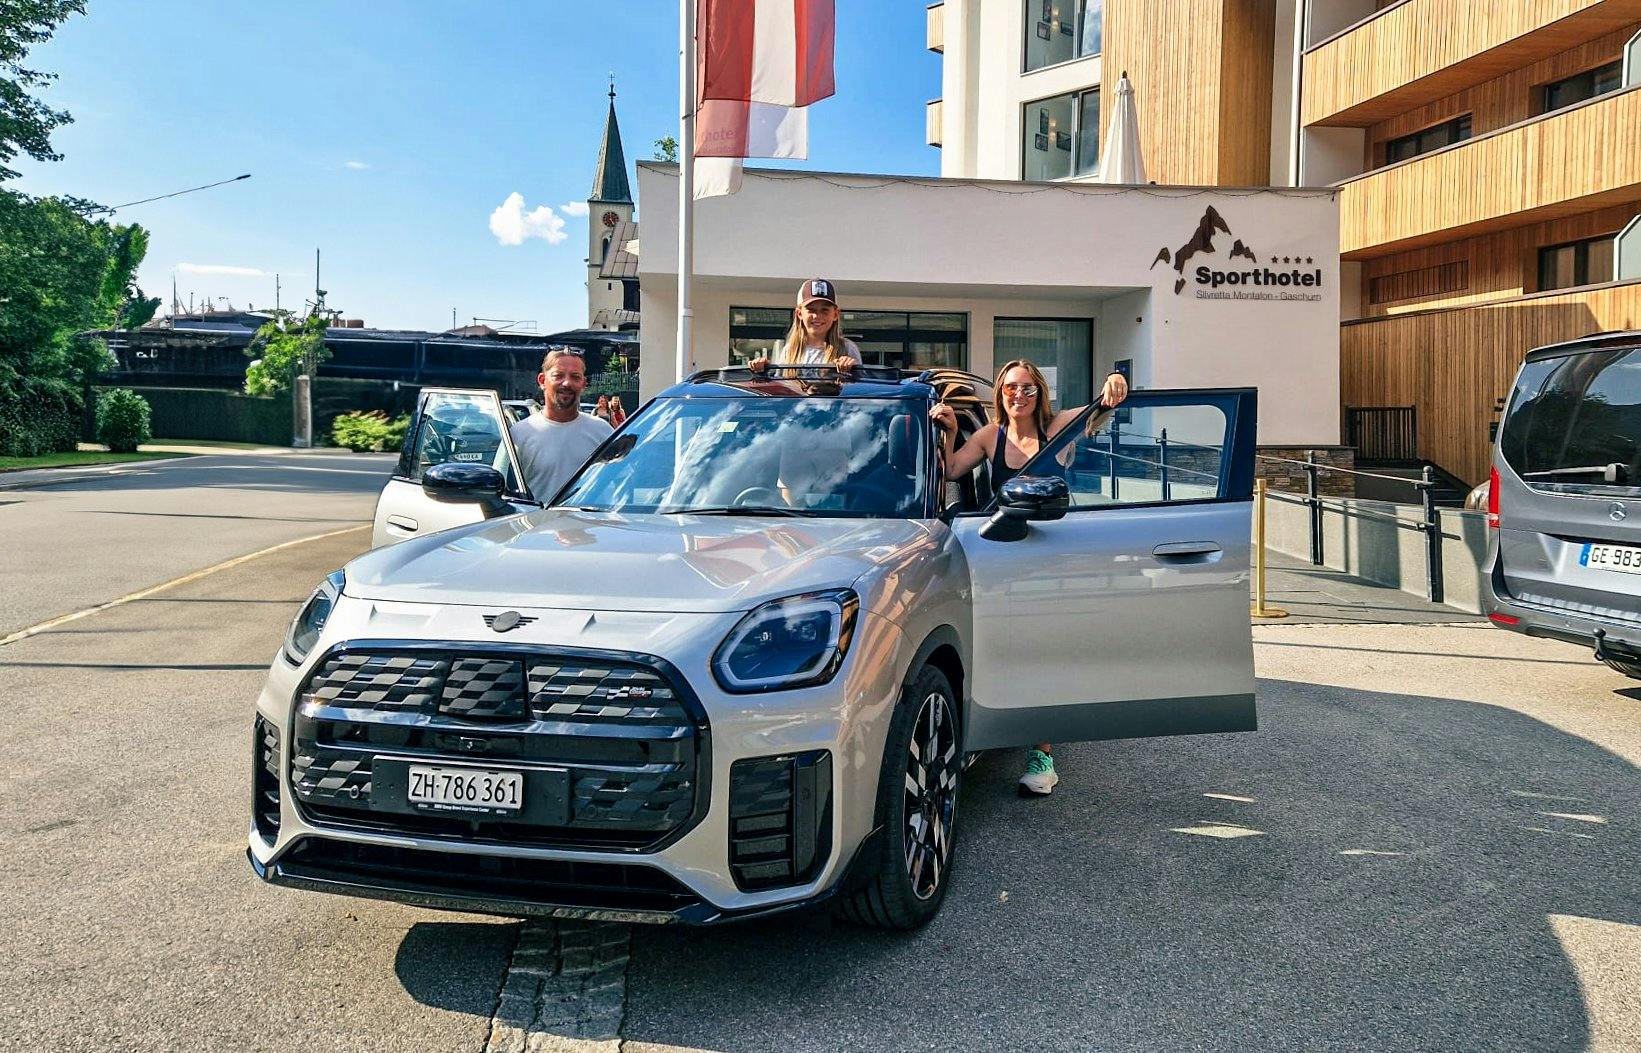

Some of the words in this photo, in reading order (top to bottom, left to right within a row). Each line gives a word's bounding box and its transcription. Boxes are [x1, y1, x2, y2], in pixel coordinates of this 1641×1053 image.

[1196, 266, 1322, 288] Sporthotel
[1196, 290, 1231, 299] Silvretta
[481, 778, 518, 804] 361
